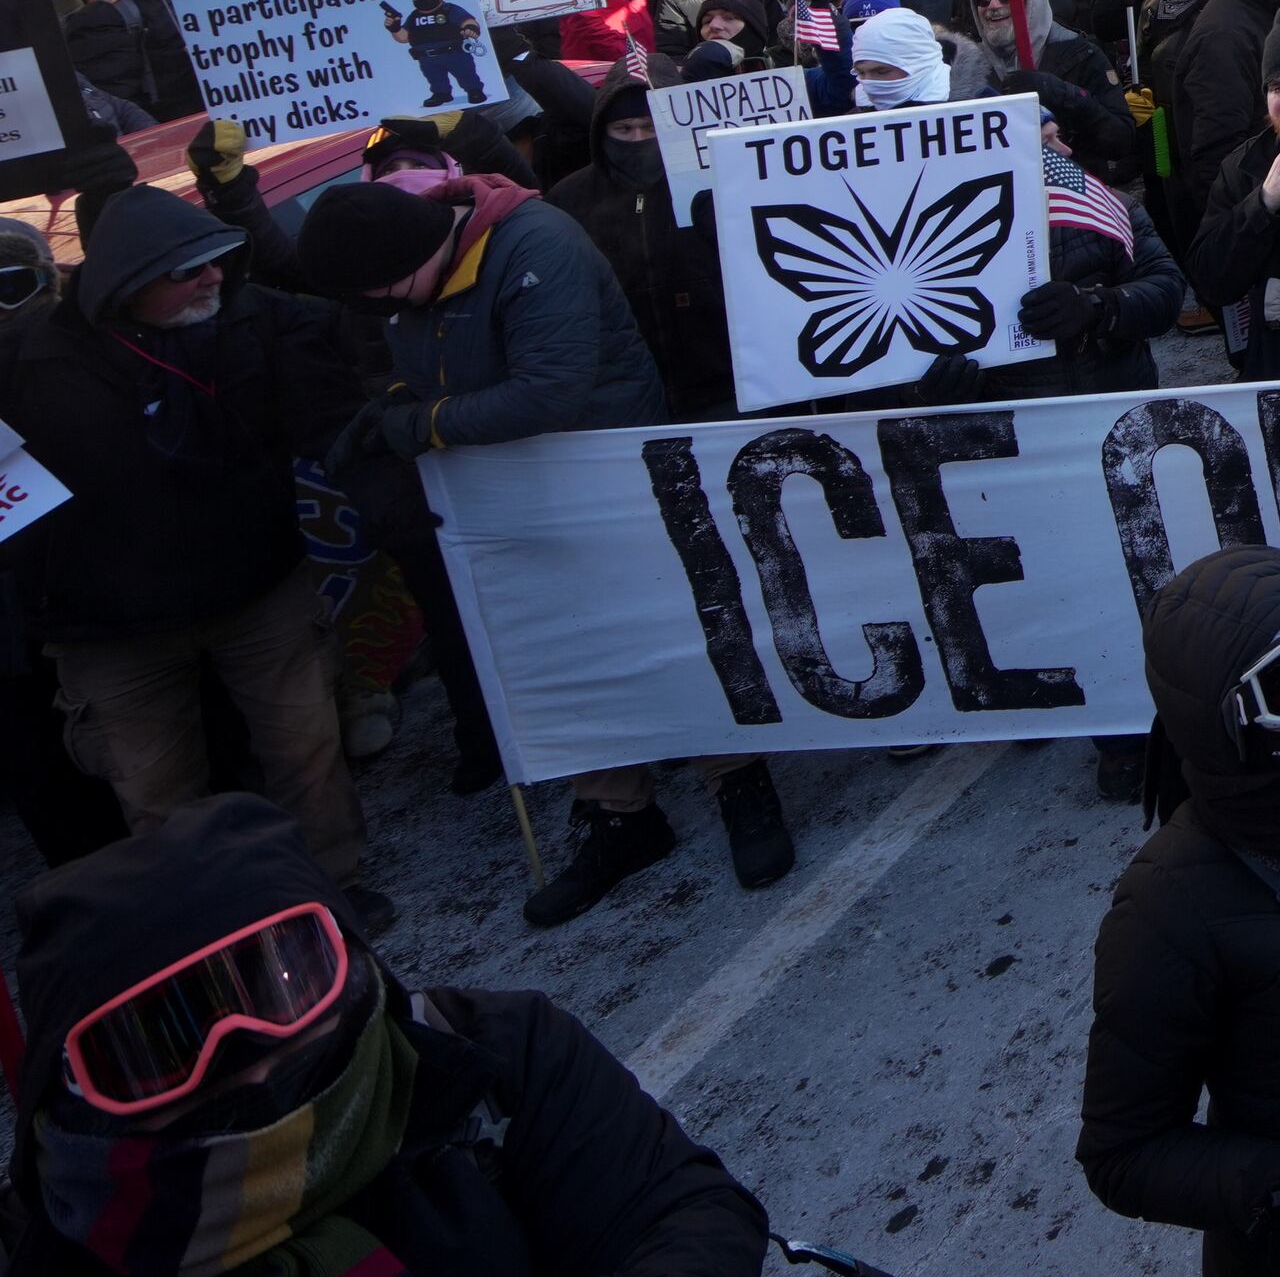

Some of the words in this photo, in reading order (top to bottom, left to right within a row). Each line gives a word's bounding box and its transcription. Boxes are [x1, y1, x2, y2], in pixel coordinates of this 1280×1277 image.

[184, 12, 200, 32] a
[192, 29, 294, 70] trophy
[302, 22, 349, 50] for
[203, 70, 300, 108] bullies
[307, 52, 373, 88] with
[668, 76, 793, 127] UNPAID
[286, 96, 370, 131] dicks.
[744, 110, 1010, 181] TOGETHER
[1014, 338, 1036, 348] RISE
[641, 410, 1087, 725] ICE
